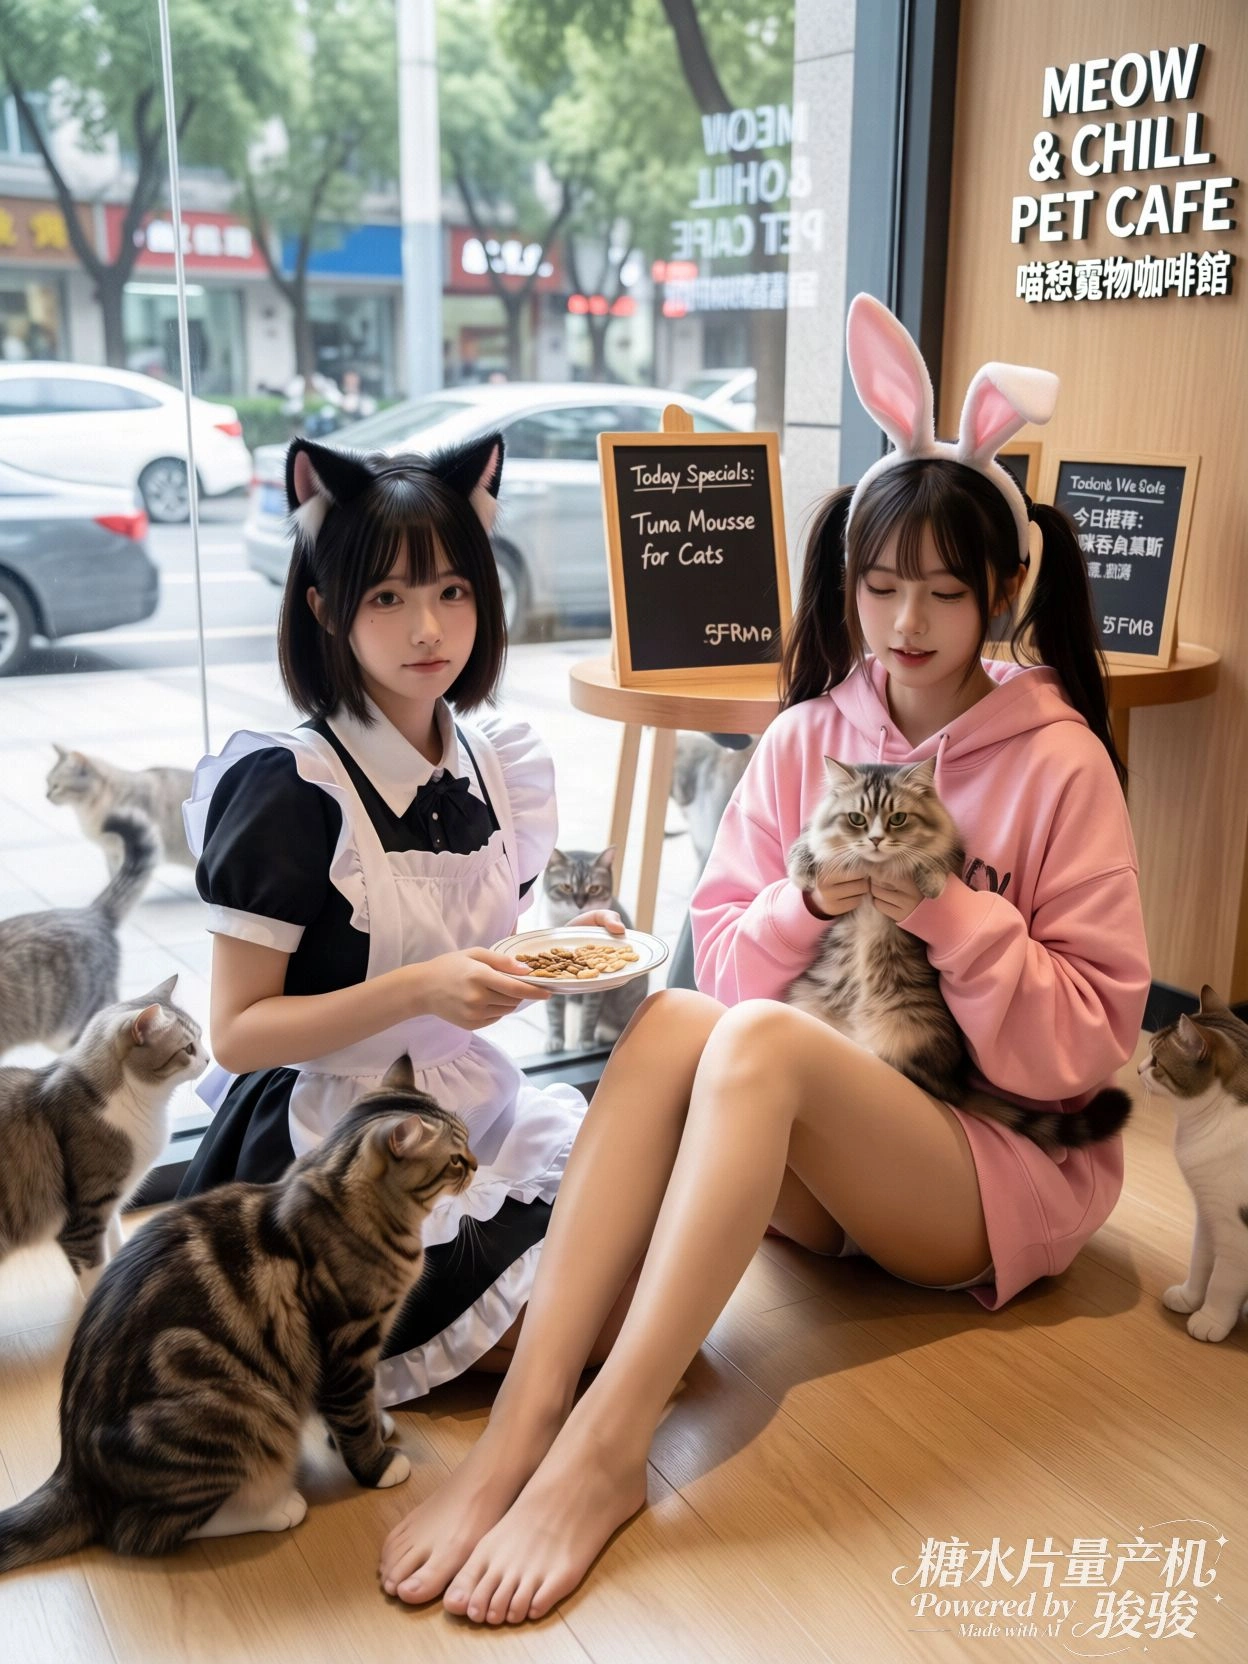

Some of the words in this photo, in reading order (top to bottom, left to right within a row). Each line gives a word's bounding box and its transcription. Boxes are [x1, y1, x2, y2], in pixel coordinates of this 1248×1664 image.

[1042, 43, 1204, 118] MEOW
[1028, 131, 1064, 182] &
[1071, 112, 1214, 177] CHILL
[1011, 190, 1097, 243] PET
[1106, 177, 1238, 238] CAFE
[630, 463, 681, 494] Today
[630, 511, 681, 536] Tuna
[688, 509, 756, 533] Mousse
[641, 543, 669, 570] for
[678, 542, 724, 566] Cats
